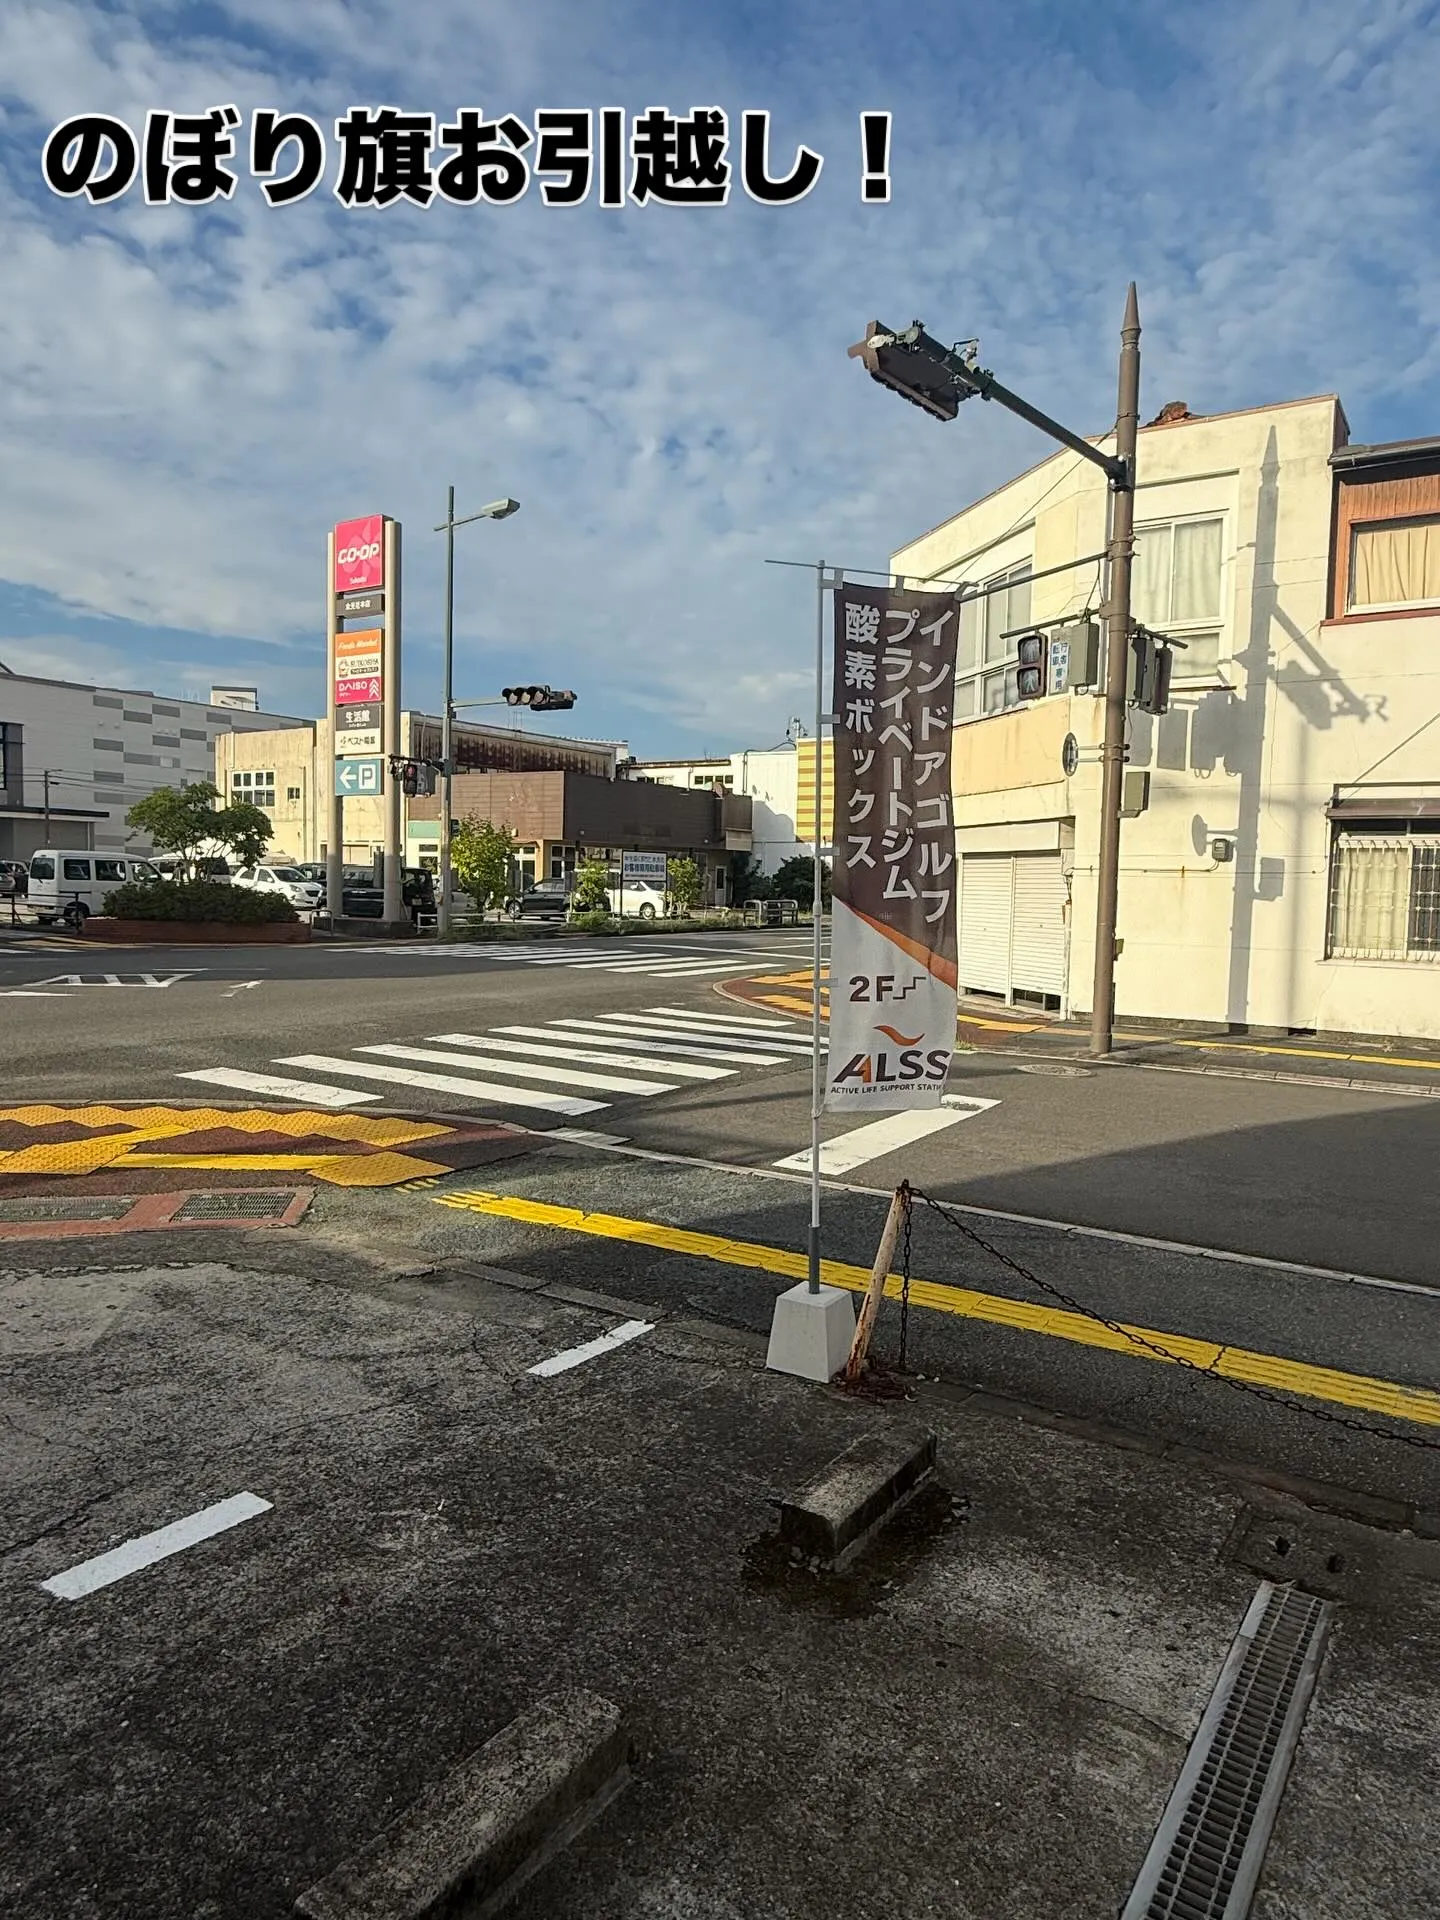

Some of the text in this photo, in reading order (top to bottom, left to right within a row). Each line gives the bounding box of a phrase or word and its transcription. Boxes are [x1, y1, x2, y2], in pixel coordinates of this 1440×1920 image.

[338, 680, 368, 692] DAISO
[844, 602, 881, 868] 酸素ボックス
[878, 608, 921, 900] プライベートジム
[914, 610, 954, 923] インドアゴルフ
[849, 975, 895, 1002] 2F
[832, 1049, 951, 1084] ALSS
[830, 1086, 859, 1094] ACTIVE
[861, 1085, 878, 1094] LIFE
[879, 1083, 916, 1093] SUPPORT
